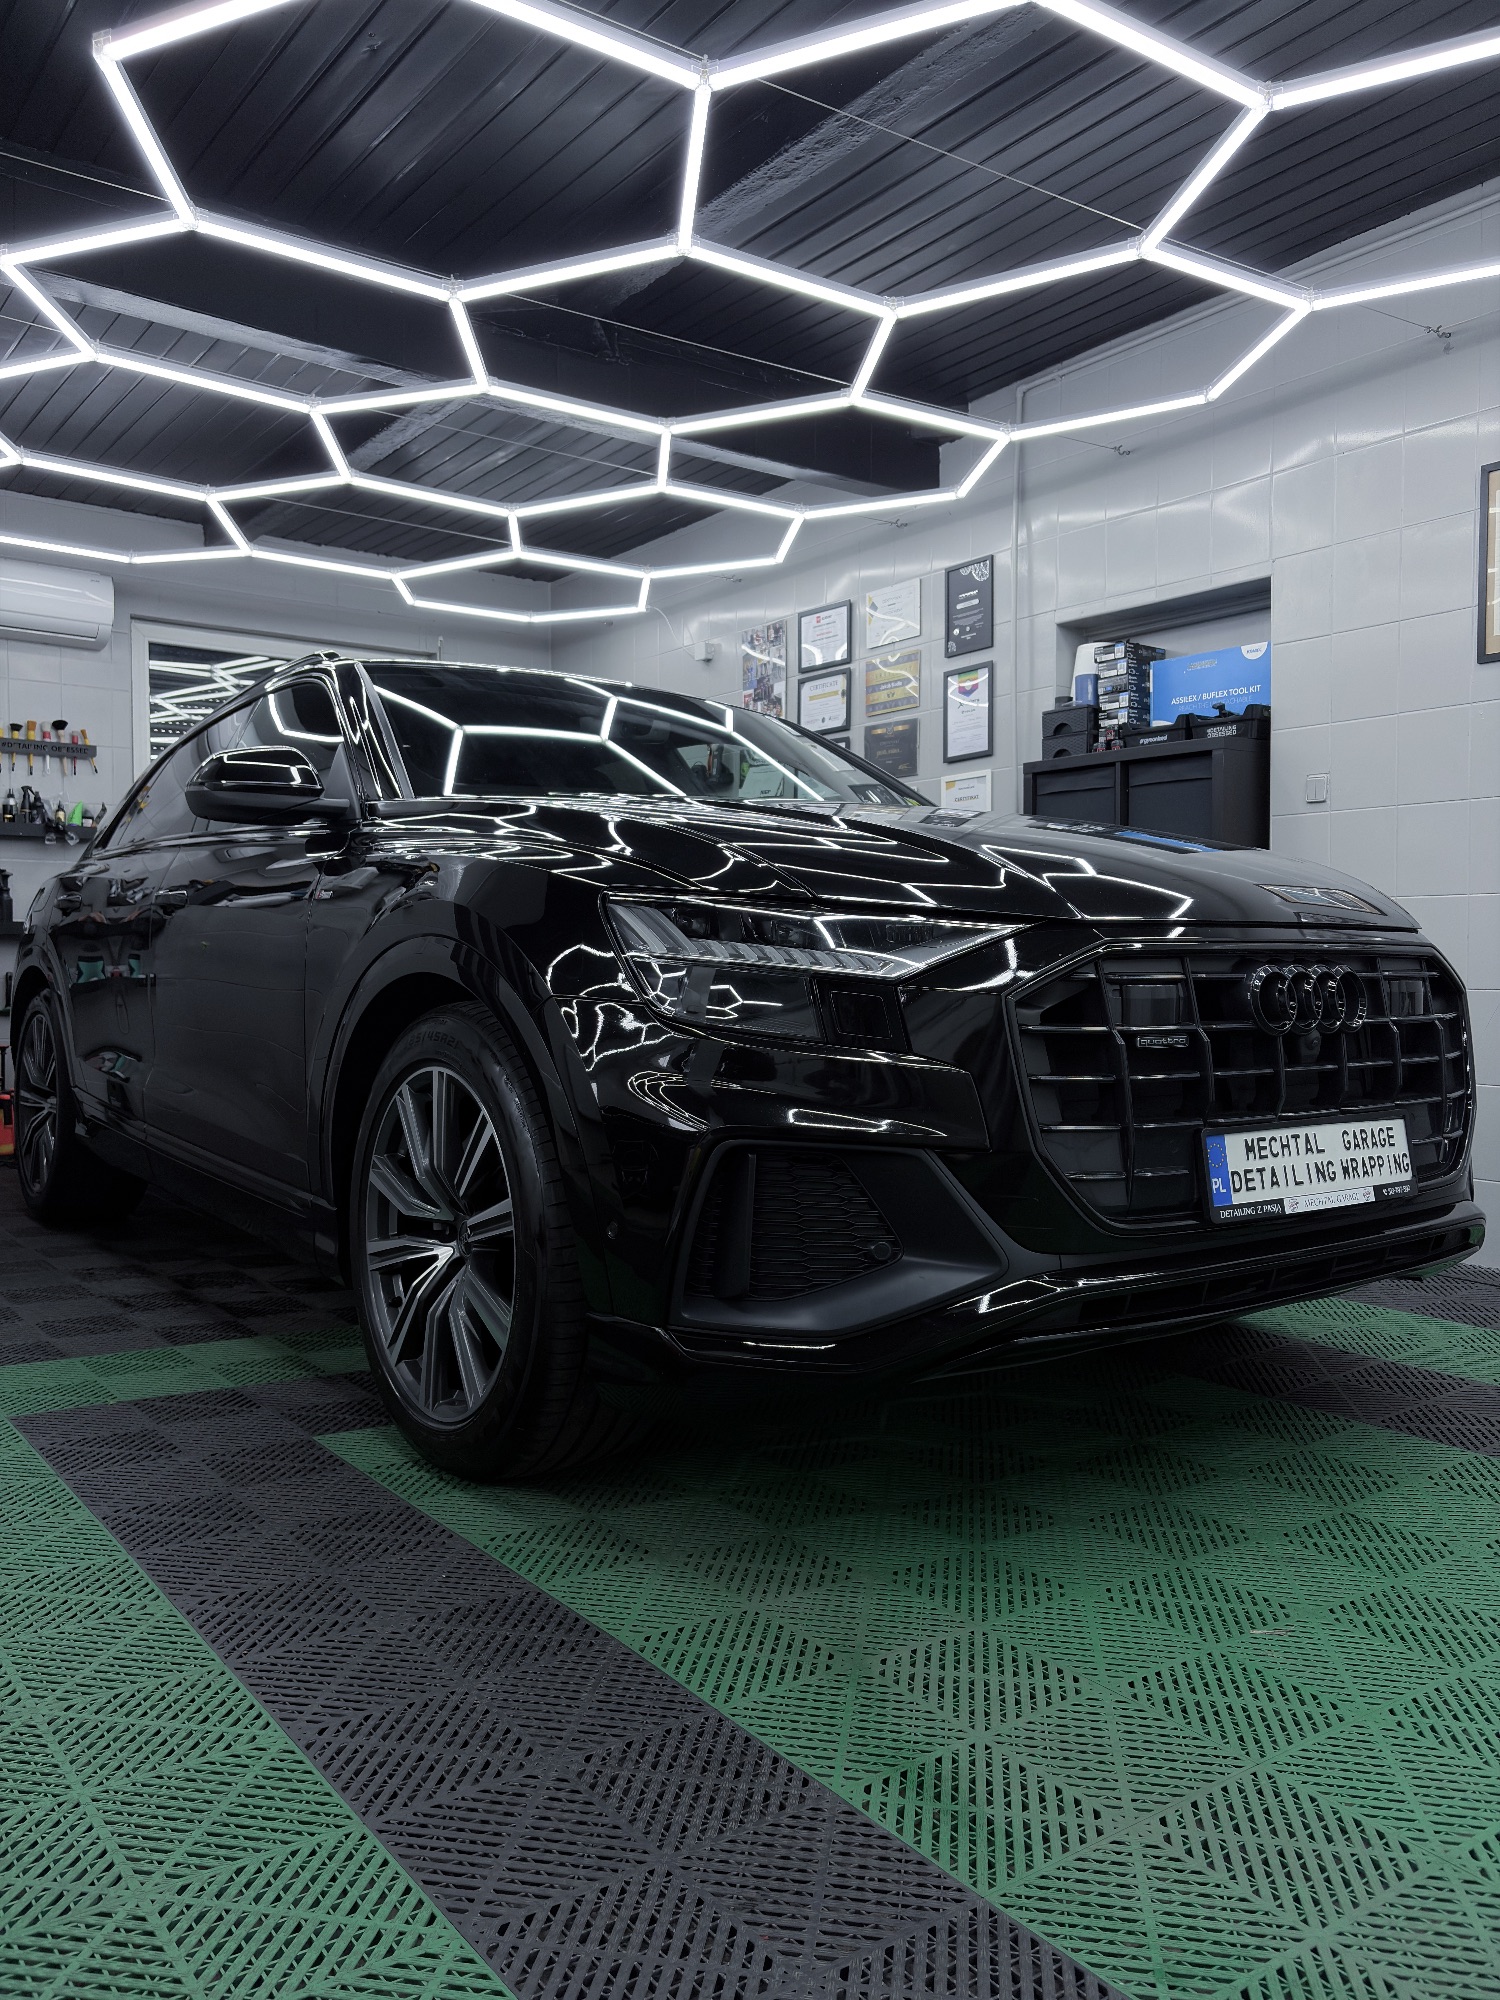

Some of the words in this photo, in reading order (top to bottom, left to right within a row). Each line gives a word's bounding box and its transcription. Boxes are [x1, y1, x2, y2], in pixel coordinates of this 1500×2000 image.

[1171, 694, 1197, 705] ASSILEX
[1202, 689, 1228, 700] BUFLEX
[1229, 687, 1249, 696] TOOL
[1249, 684, 1261, 693] KIT
[1140, 1037, 1186, 1047] quattro
[1244, 1132, 1326, 1161] MECHTAL
[1341, 1126, 1396, 1151] GARAGE
[1230, 1160, 1337, 1193] DETAILING
[1340, 1152, 1410, 1180] WRAPPING
[1212, 1178, 1227, 1194] PL
[1219, 1206, 1256, 1219] DETAILING
[1256, 1206, 1263, 1214] Z
